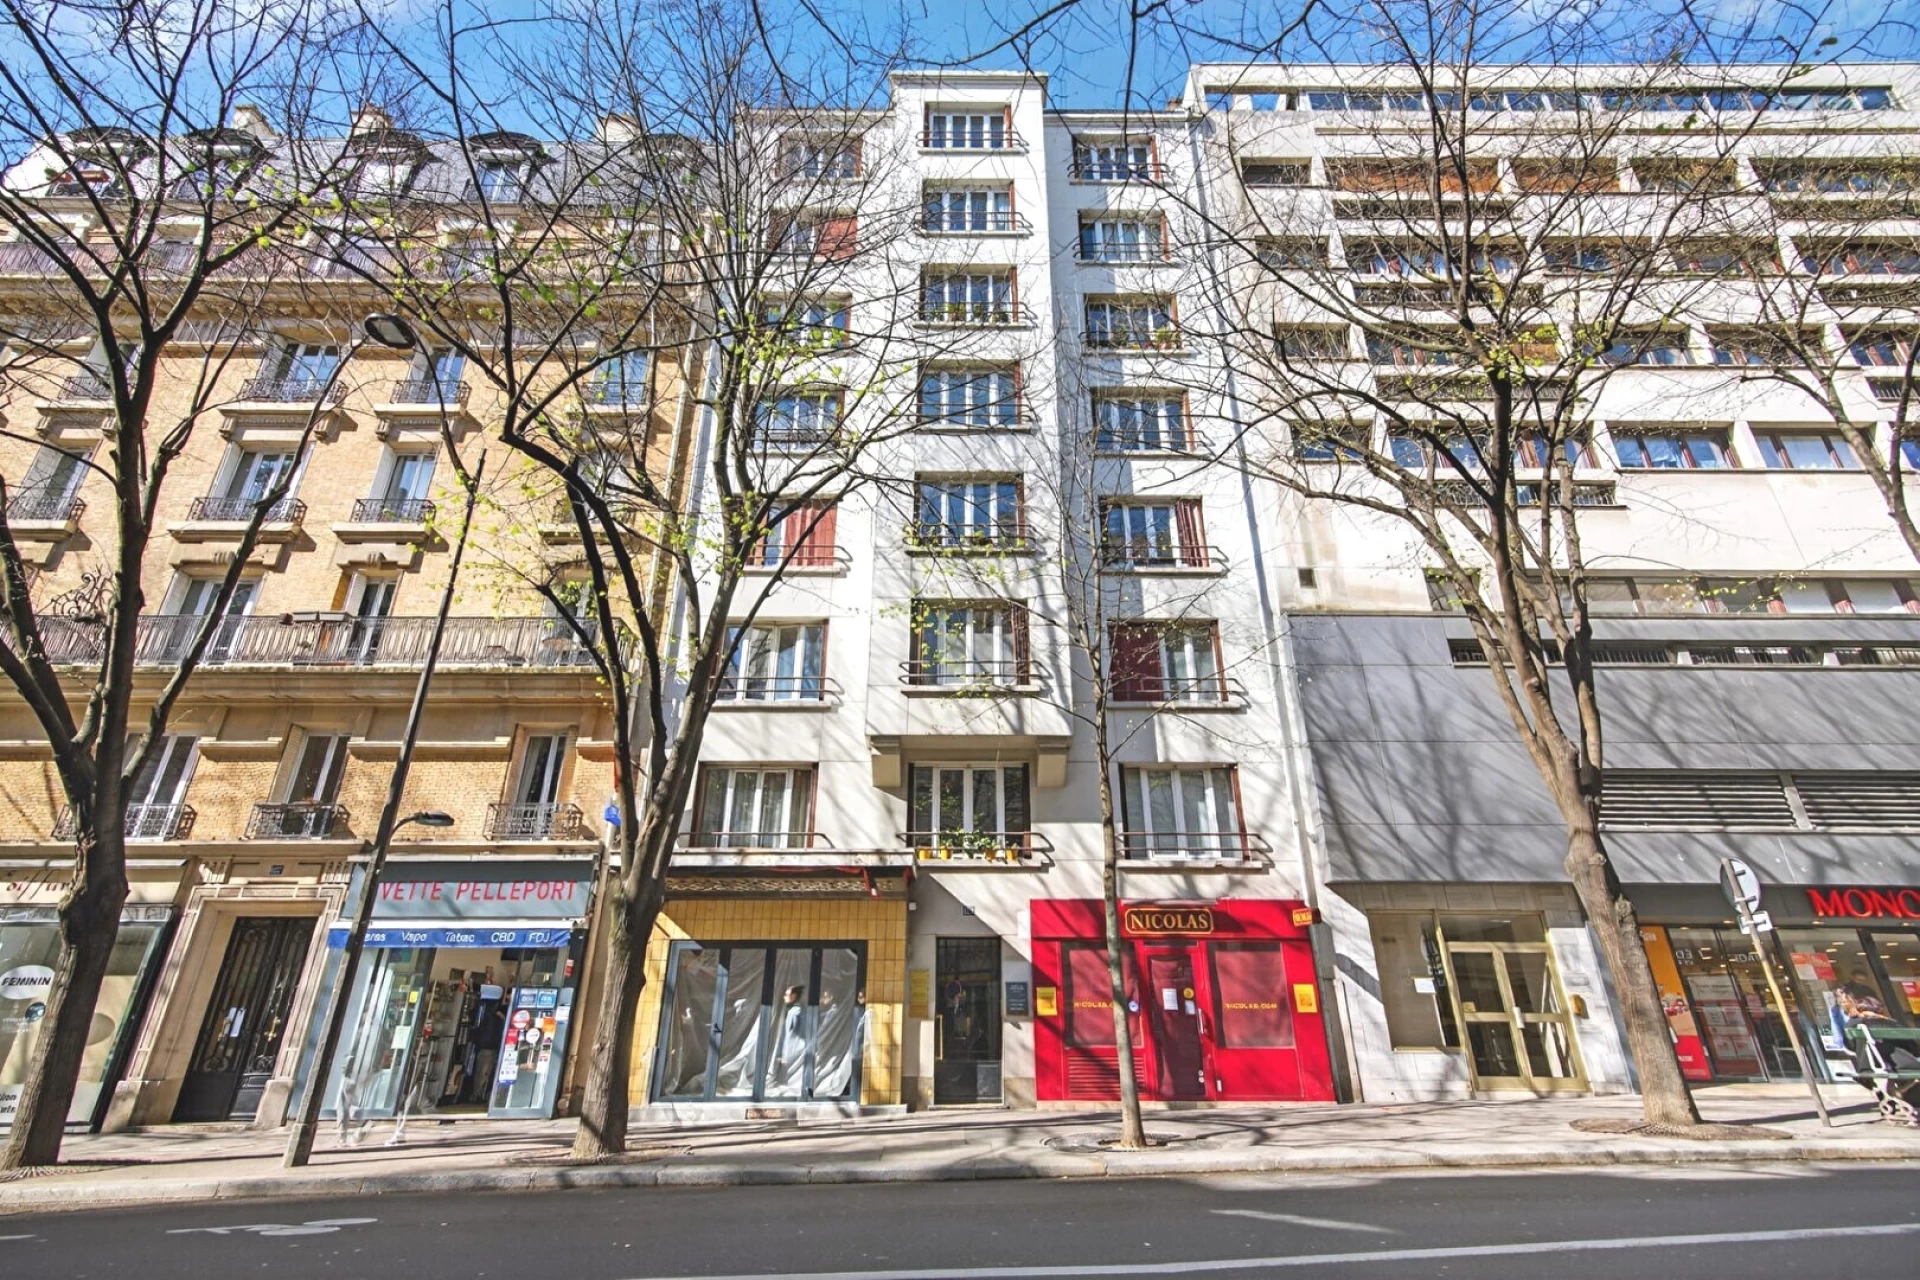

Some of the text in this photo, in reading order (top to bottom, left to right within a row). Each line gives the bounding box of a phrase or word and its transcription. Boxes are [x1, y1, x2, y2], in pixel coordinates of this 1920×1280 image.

[380, 880, 576, 901] VETTE PELLEPORT
[1130, 914, 1209, 930] NICOLAS
[491, 932, 516, 942] CBD
